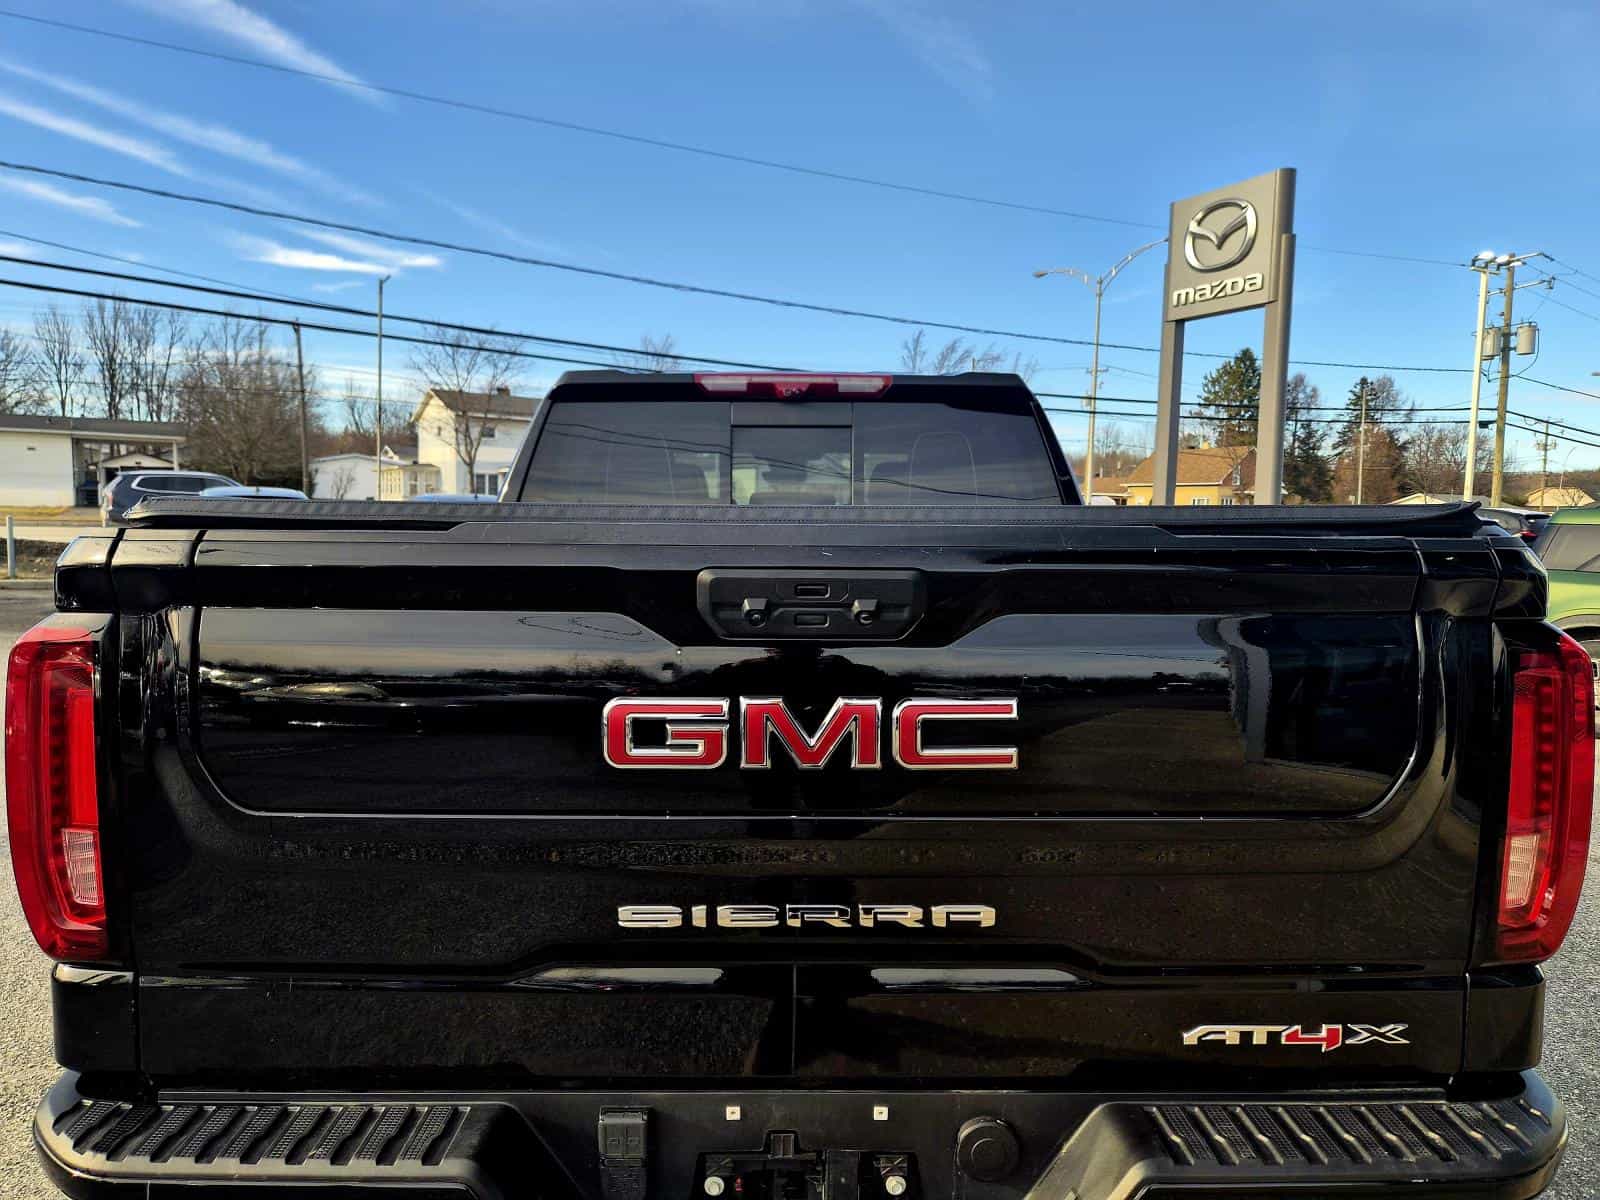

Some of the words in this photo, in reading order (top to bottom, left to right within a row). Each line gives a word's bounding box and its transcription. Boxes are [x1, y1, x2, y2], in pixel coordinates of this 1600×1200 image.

[1172, 272, 1265, 307] mazda
[602, 696, 1020, 770] GMC
[617, 904, 997, 928] SIERRA
[1182, 1023, 1411, 1053] AT4X
